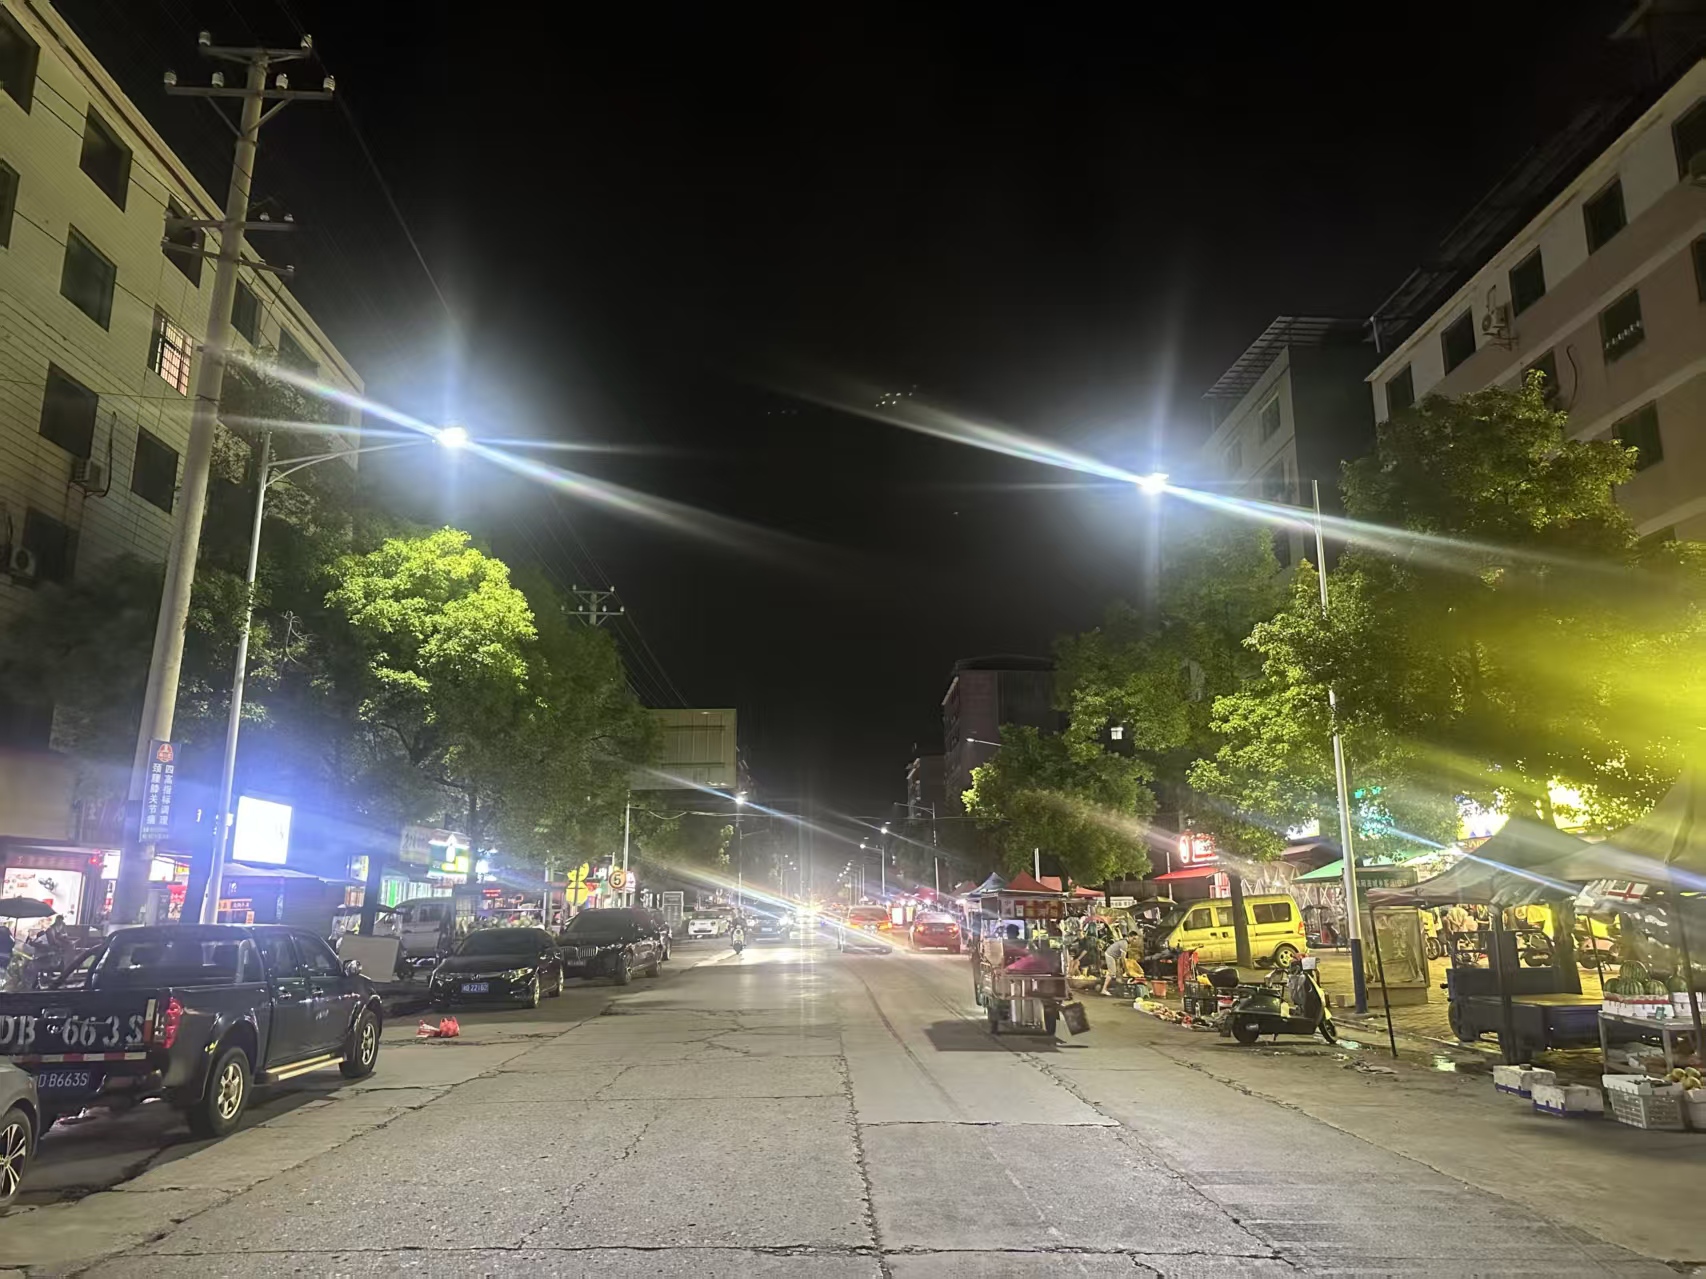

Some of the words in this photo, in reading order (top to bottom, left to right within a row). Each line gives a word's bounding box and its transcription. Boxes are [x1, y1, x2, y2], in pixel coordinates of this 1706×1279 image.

[160, 765, 174, 825] 四高指标调理
[613, 873, 622, 886] 5
